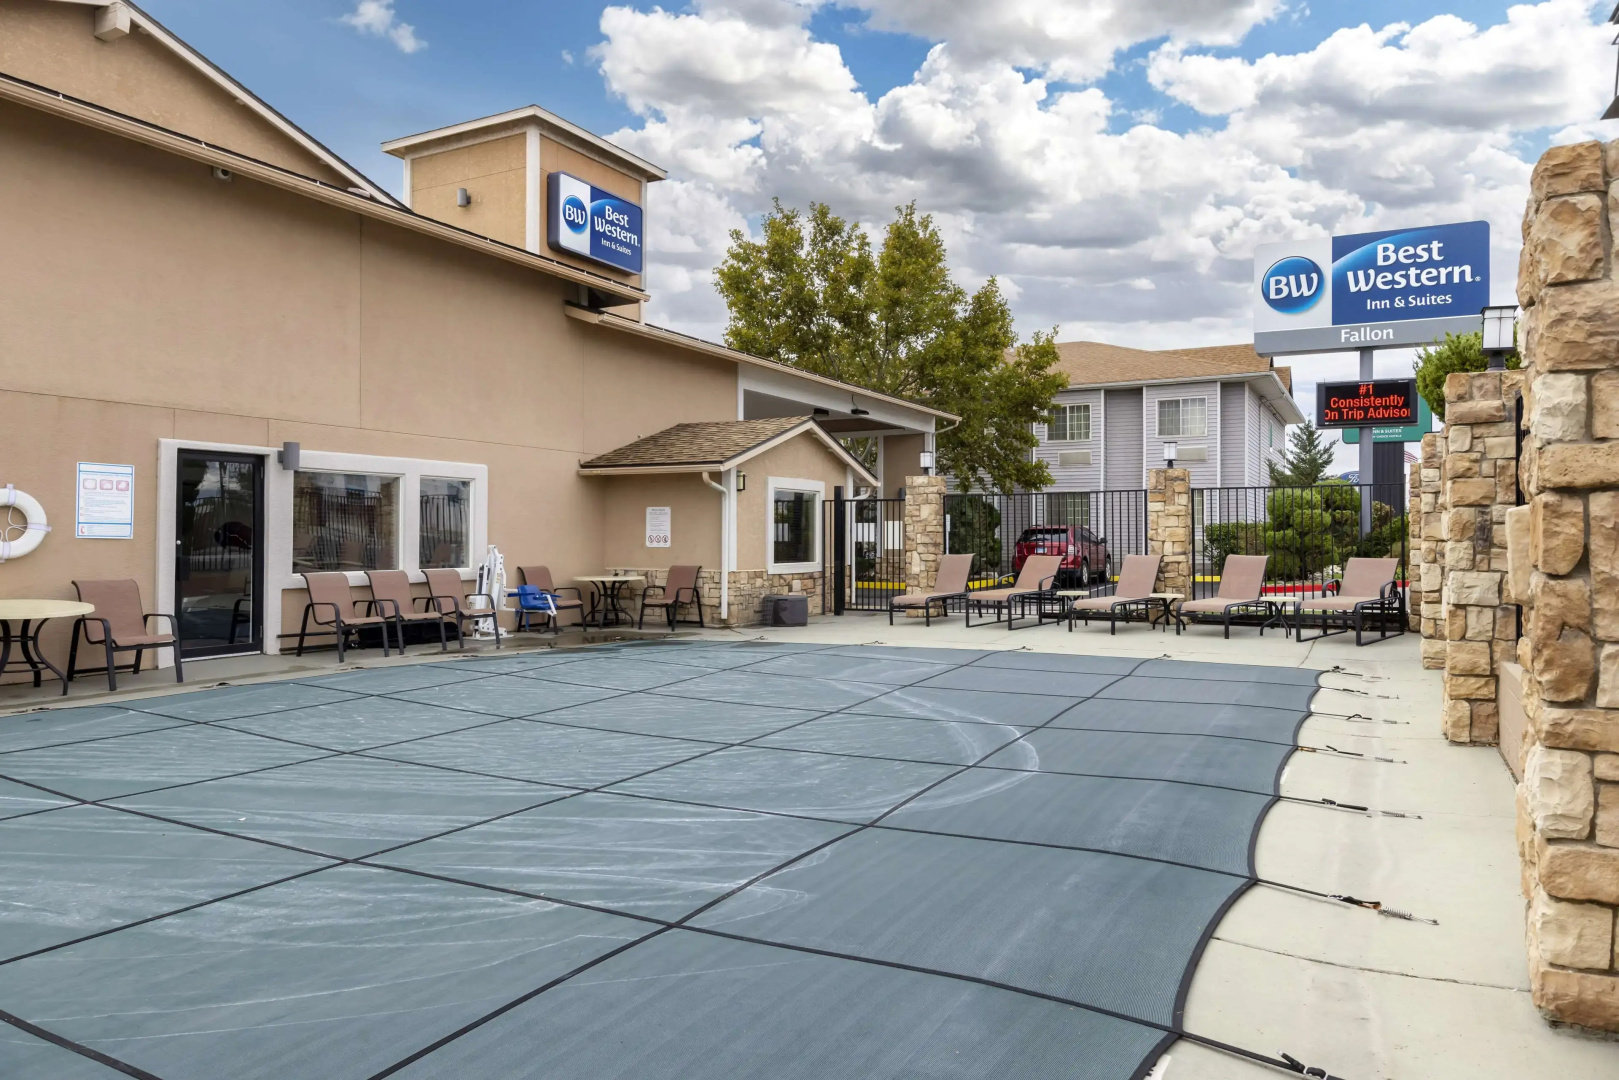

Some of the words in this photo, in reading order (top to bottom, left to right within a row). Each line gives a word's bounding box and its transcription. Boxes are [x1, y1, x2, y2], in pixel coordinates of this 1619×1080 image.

[565, 205, 585, 224] BW
[605, 205, 629, 228] Best
[601, 238, 610, 248] Inn
[611, 241, 616, 250] &
[616, 243, 632, 256] Suites
[1376, 240, 1444, 266] Best
[1269, 272, 1319, 300] BW
[1366, 298, 1390, 310] Inn
[1394, 297, 1405, 308] &
[1408, 293, 1452, 307] Suites
[1341, 327, 1394, 343] Fallon
[1359, 384, 1373, 395] #1
[1330, 395, 1405, 408] Consistently
[1342, 408, 1364, 420] Trip
